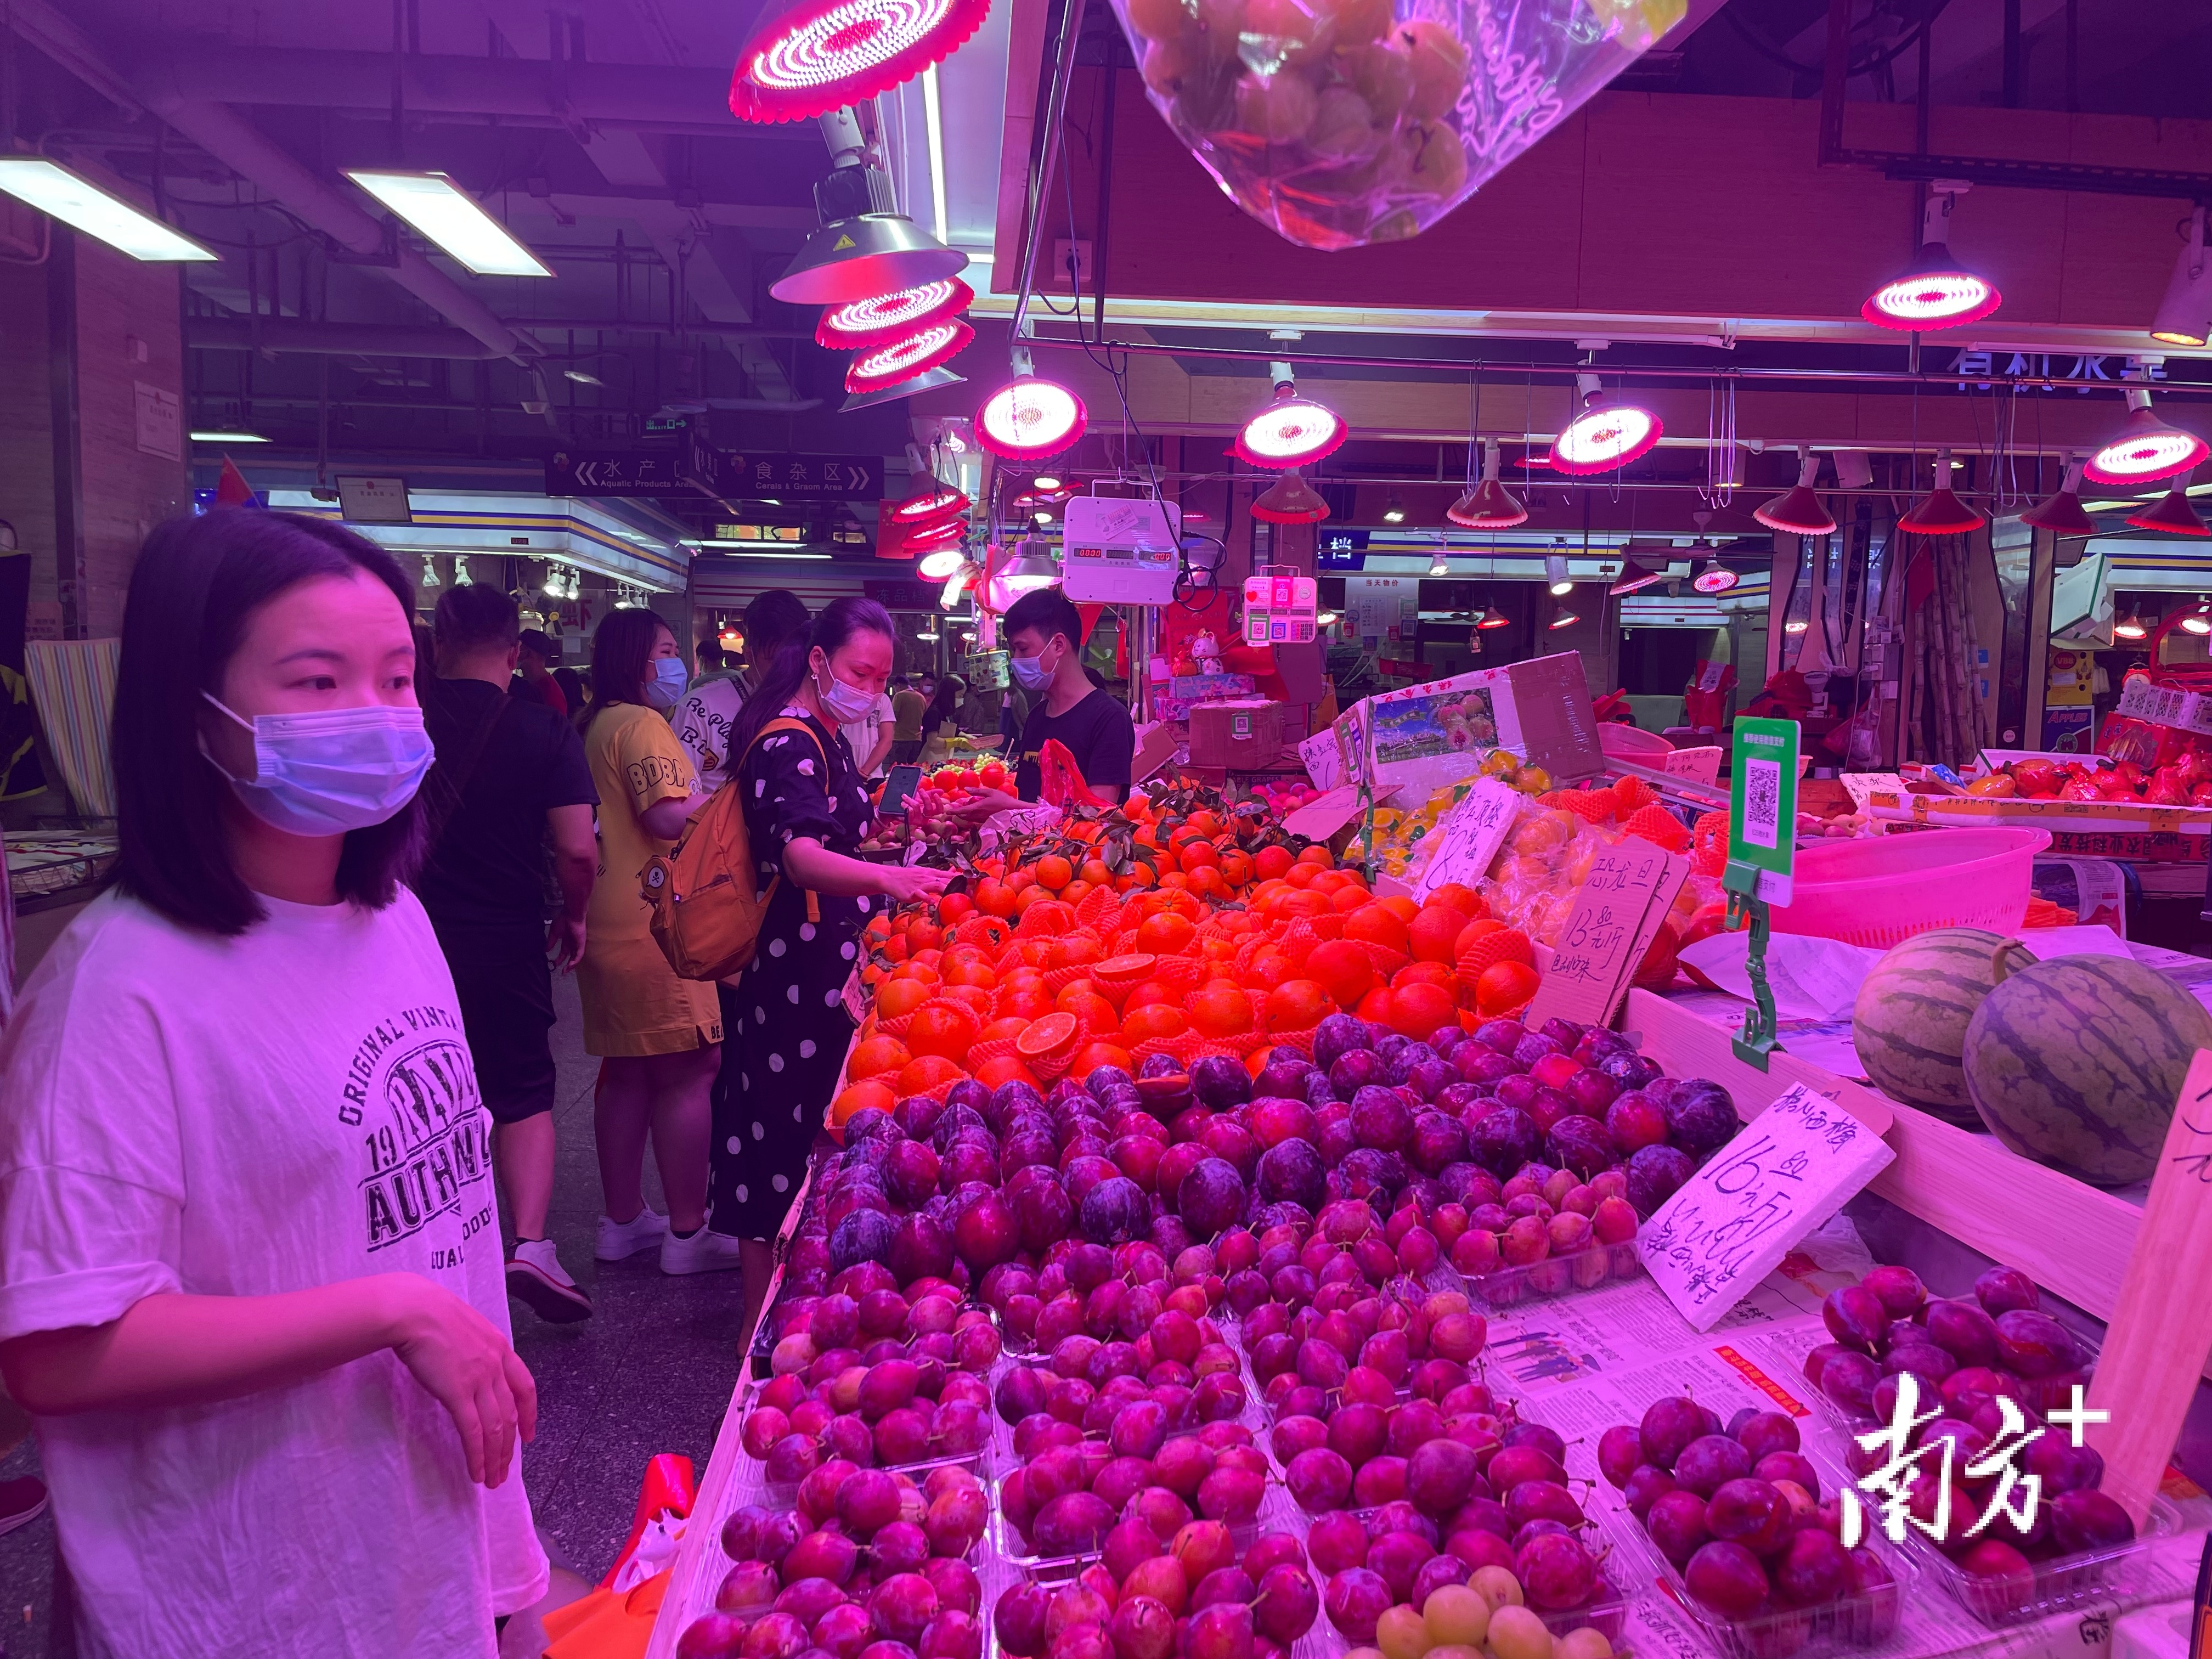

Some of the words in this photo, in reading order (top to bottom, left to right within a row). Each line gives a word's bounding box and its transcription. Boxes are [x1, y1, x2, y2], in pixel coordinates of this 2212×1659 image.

[755, 461, 842, 481] 食杂区
[601, 479, 632, 488] Aquatic
[635, 480, 671, 488] Products
[823, 483, 843, 491] Area
[1318, 537, 1352, 560] 档
[1365, 579, 1399, 587] 当天物价
[876, 588, 925, 603] 冻品档
[686, 697, 706, 718] Be
[338, 1017, 405, 1127] ORIGINAL
